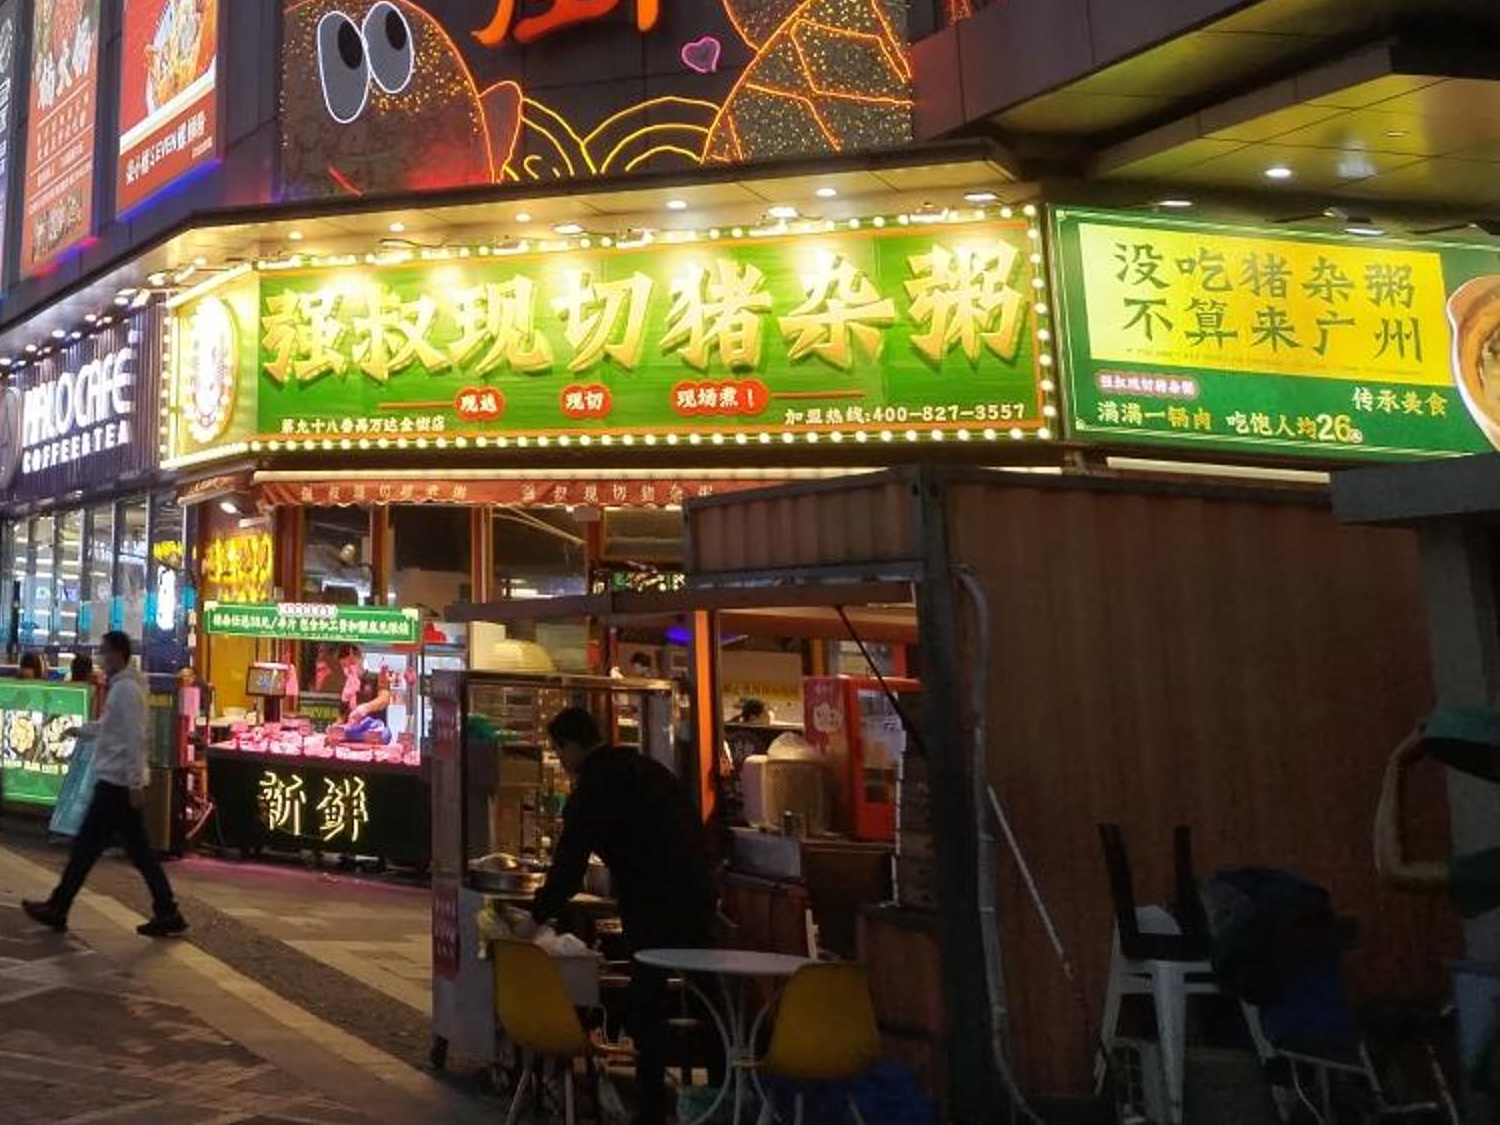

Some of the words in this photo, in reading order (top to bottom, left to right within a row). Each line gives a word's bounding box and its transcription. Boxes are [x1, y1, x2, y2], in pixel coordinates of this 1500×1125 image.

[1113, 244, 1414, 309] 没吃猪杂粥
[261, 240, 1026, 383] 强叔现切猪杂粥
[1122, 297, 1424, 362] 不算来广州
[565, 390, 605, 412] 现切
[1097, 400, 1212, 431] 满满一锅肉
[1352, 386, 1448, 418] 传承美食
[260, 770, 369, 843] 新鲜
